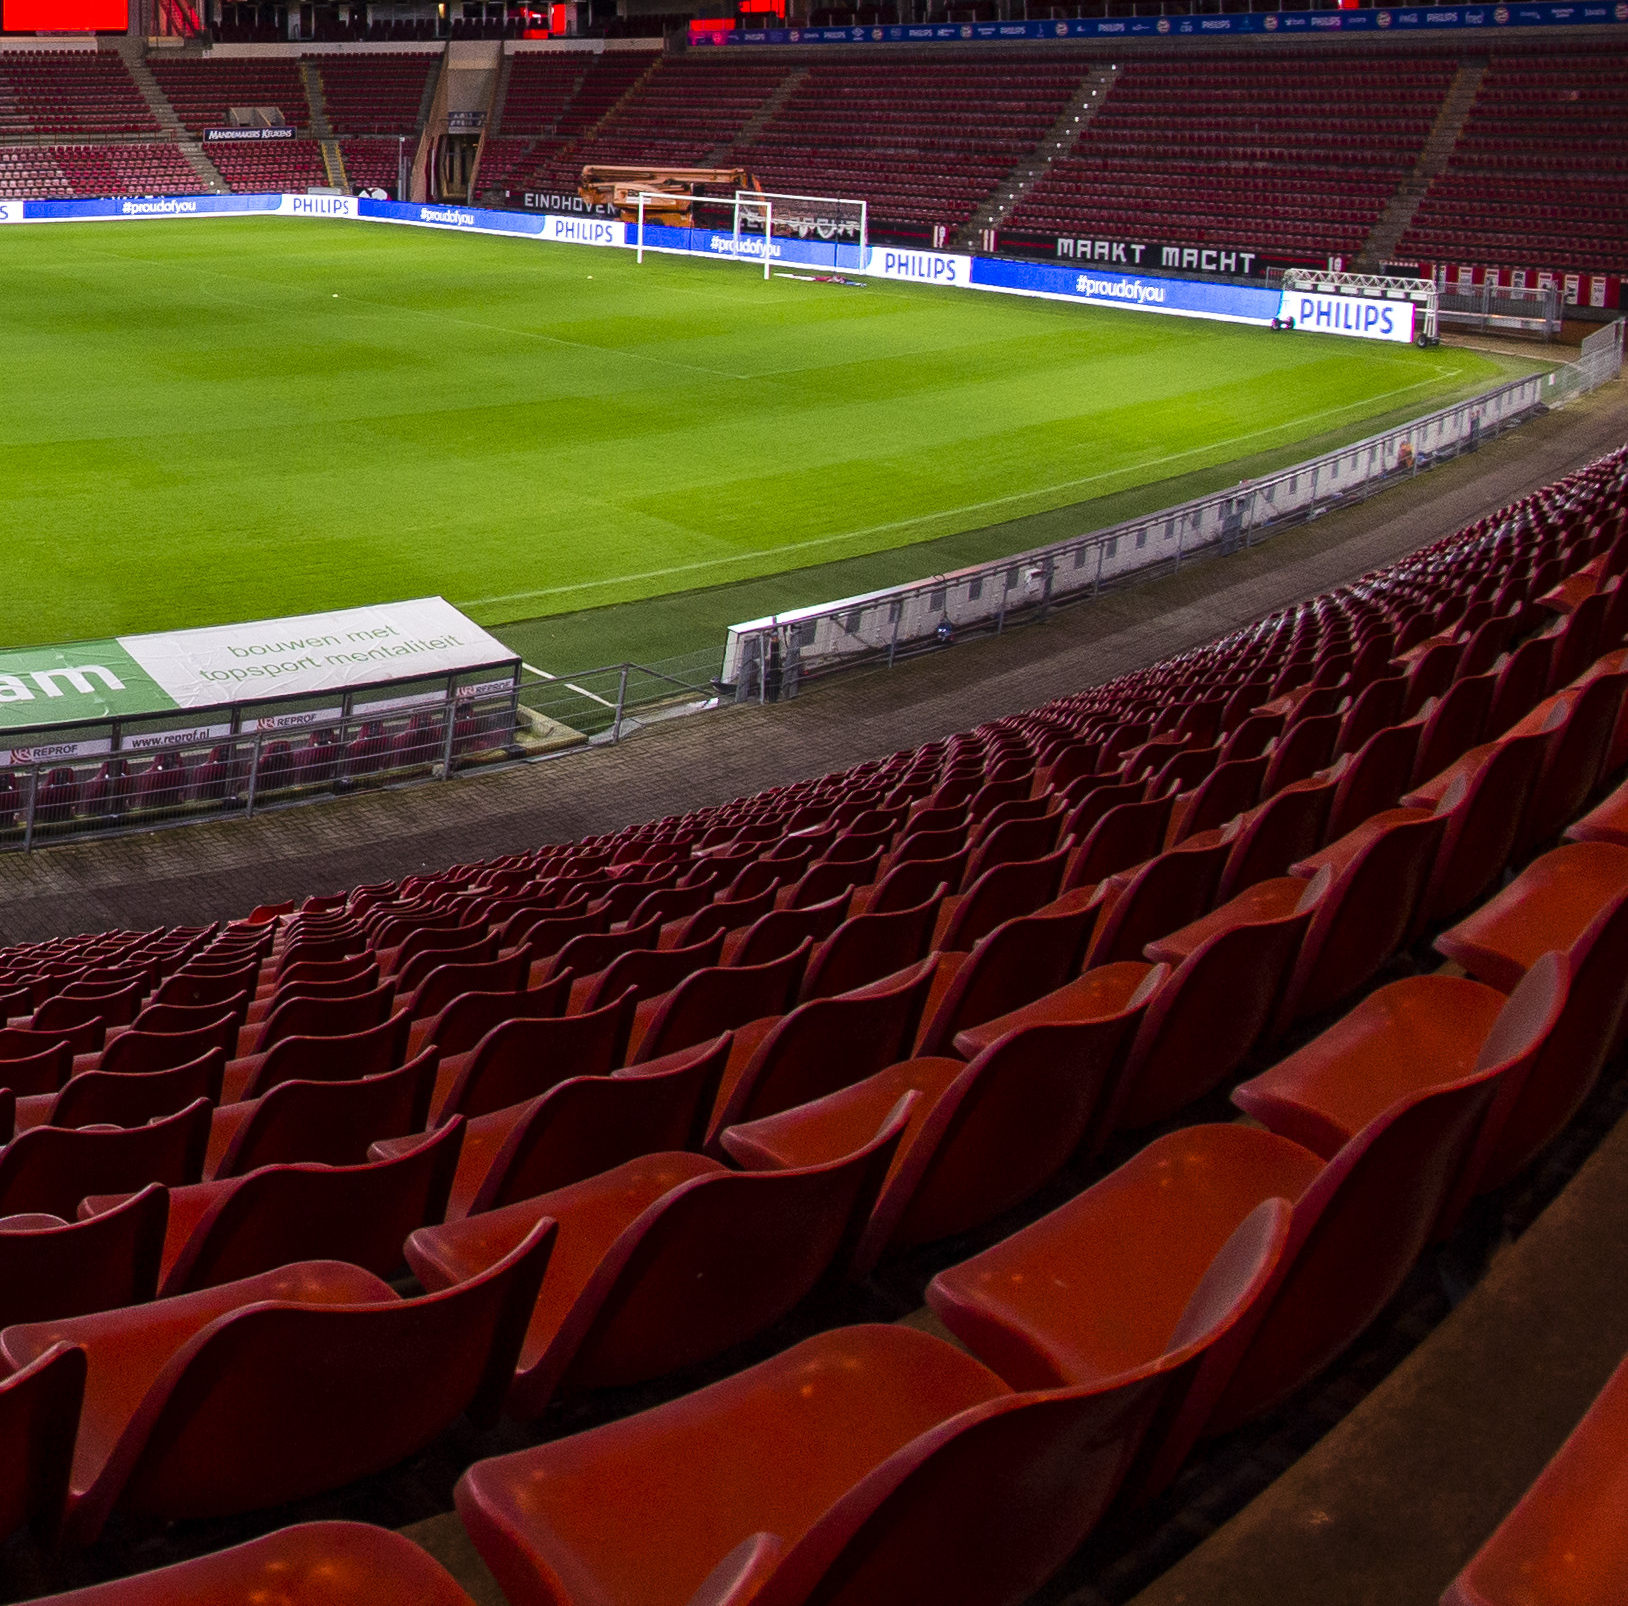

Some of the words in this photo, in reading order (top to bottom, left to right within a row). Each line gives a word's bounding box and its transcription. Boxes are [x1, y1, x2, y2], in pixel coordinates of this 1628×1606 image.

[122, 198, 196, 214] #proudofyou
[294, 198, 349, 215] PHILIPS
[420, 207, 475, 226] #proudofyou
[555, 220, 613, 243] PHILIPS
[885, 253, 956, 281] PHILIPS
[1057, 237, 1146, 264] MAAKT
[1162, 246, 1255, 274] MACHT
[1076, 275, 1164, 302] #proudofyou
[1300, 298, 1393, 334] PHILIPS
[227, 633, 341, 659] bouwen
[346, 624, 401, 642] met
[199, 656, 323, 684] topsport
[325, 634, 464, 665] mentaliteit
[277, 713, 317, 727] REPROF
[131, 728, 210, 749] www.reprof.nl
[33, 744, 79, 758] REPROF
